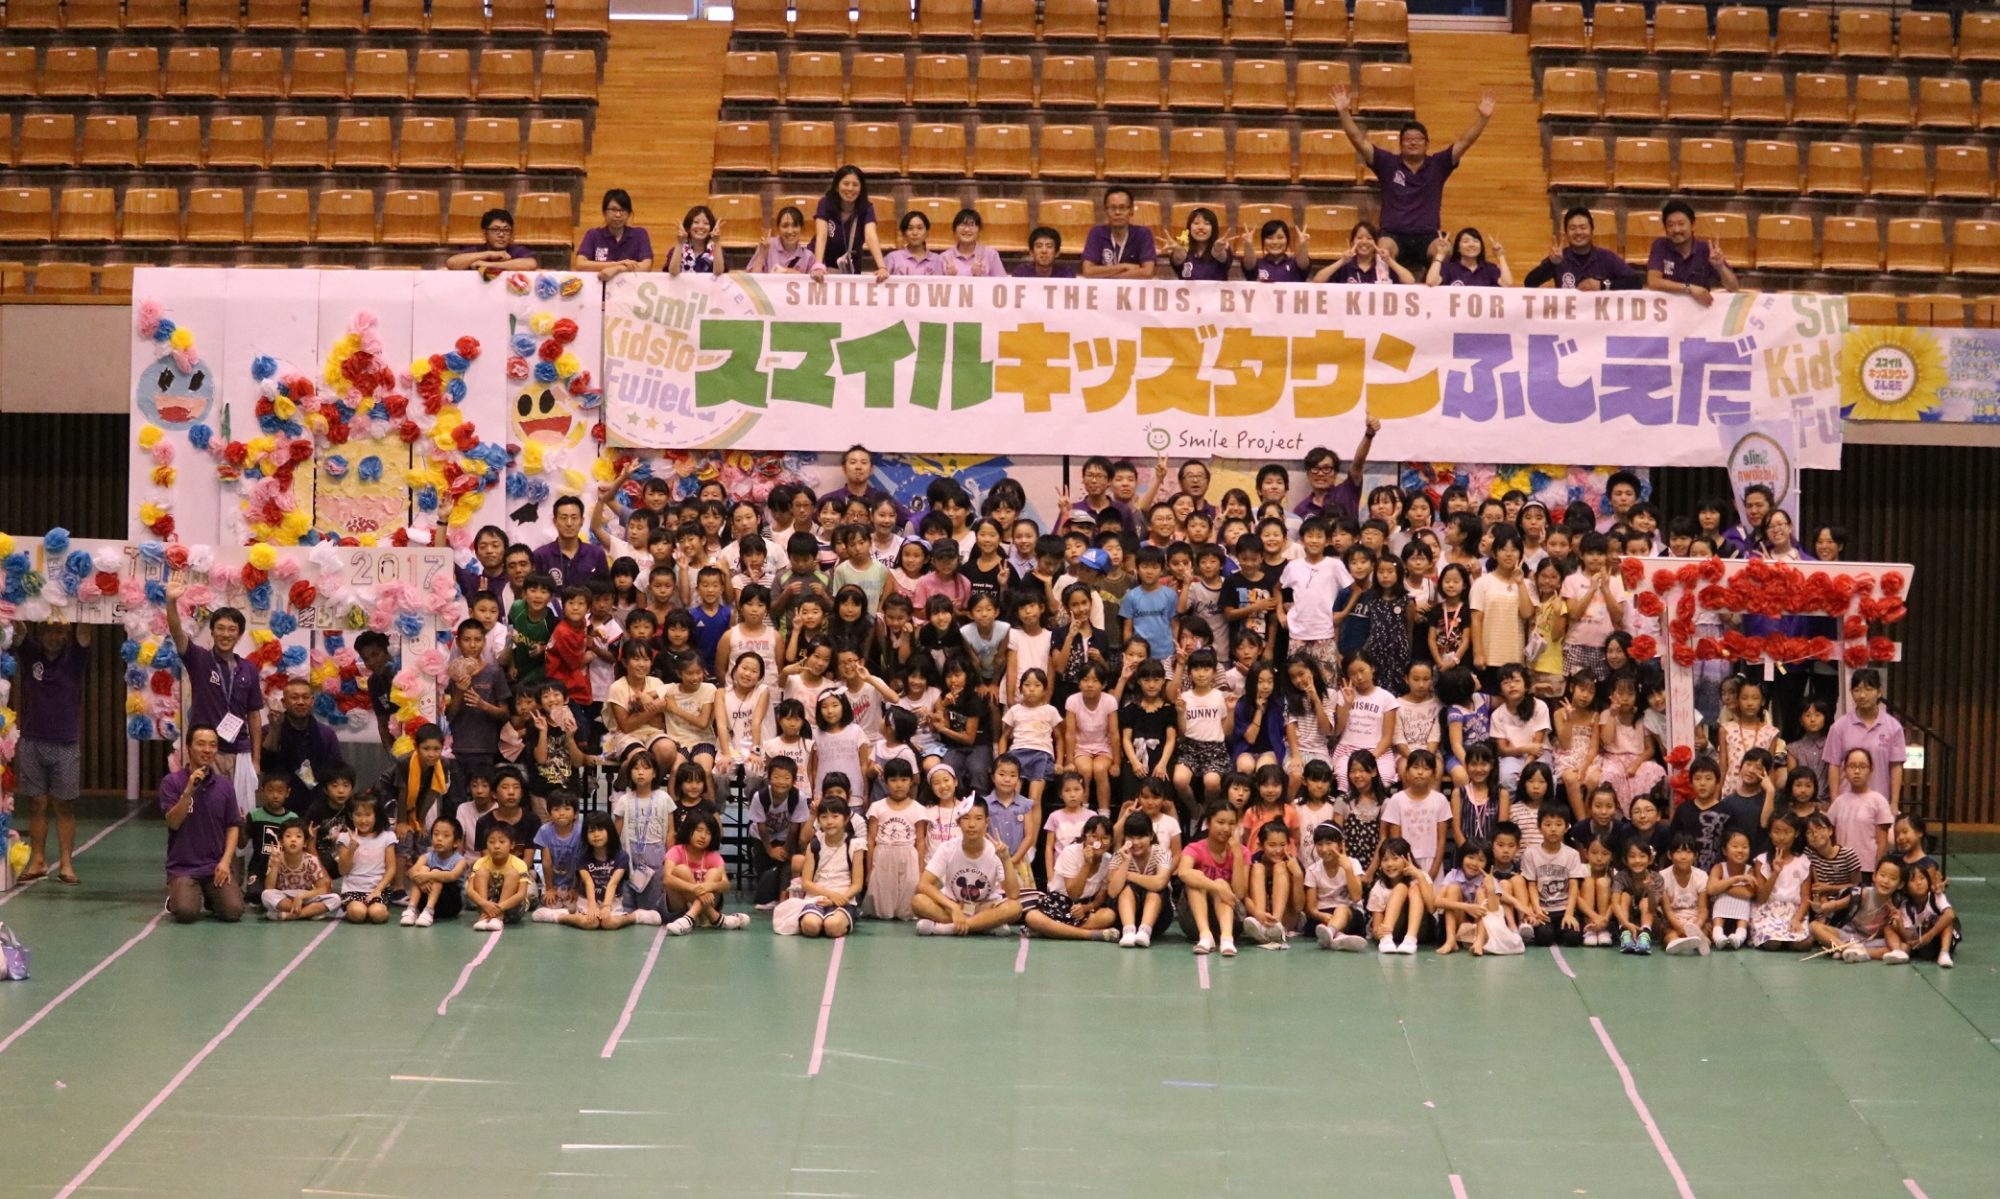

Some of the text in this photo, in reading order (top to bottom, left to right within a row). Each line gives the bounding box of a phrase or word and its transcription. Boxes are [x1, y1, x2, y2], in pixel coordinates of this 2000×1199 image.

[786, 281, 1668, 322] SMILETOWN OF THE KIDS, BY THE KIDS, FOR THE KIDS
[1179, 429, 1305, 453] Smile Project
[351, 551, 445, 589] 2017
[1186, 708, 1219, 722] SUNNY
